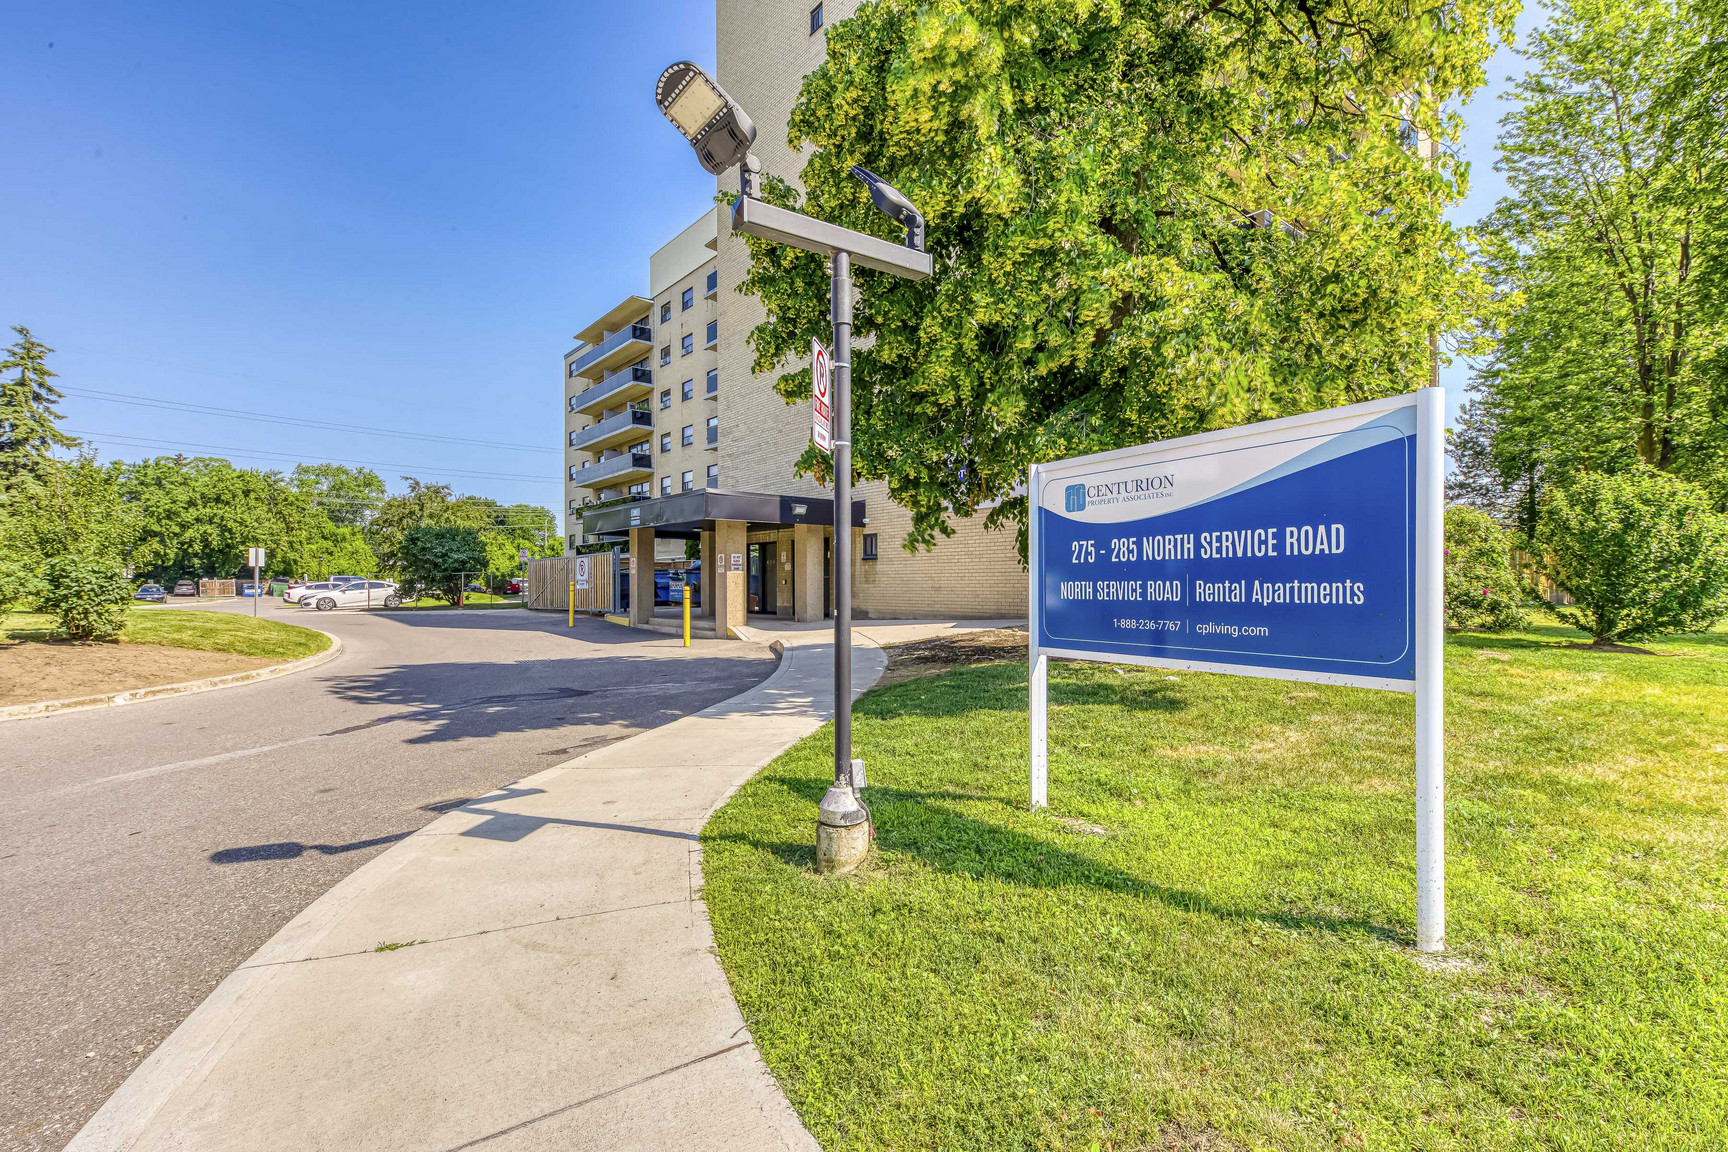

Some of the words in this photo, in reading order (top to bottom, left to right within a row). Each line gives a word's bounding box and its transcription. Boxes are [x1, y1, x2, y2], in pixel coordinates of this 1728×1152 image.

[1087, 474, 1174, 498] CENTURION
[1087, 497, 1119, 507] PROPERTY
[1121, 491, 1165, 503] ASSOCIATES
[1072, 540, 1095, 563] 275
[1111, 537, 1137, 562] 285
[1143, 533, 1194, 560] NORTH
[1200, 528, 1277, 559] SERVICE
[1286, 523, 1345, 555] ROAD
[1060, 581, 1093, 600] NORTH
[1097, 581, 1142, 600] SERVICE
[1147, 580, 1180, 601] ROAD
[1195, 580, 1245, 602] Rental
[1252, 579, 1364, 606] Apartments
[1113, 618, 1181, 631] 1-888-236-7767
[1196, 622, 1268, 638] cpliving.com
